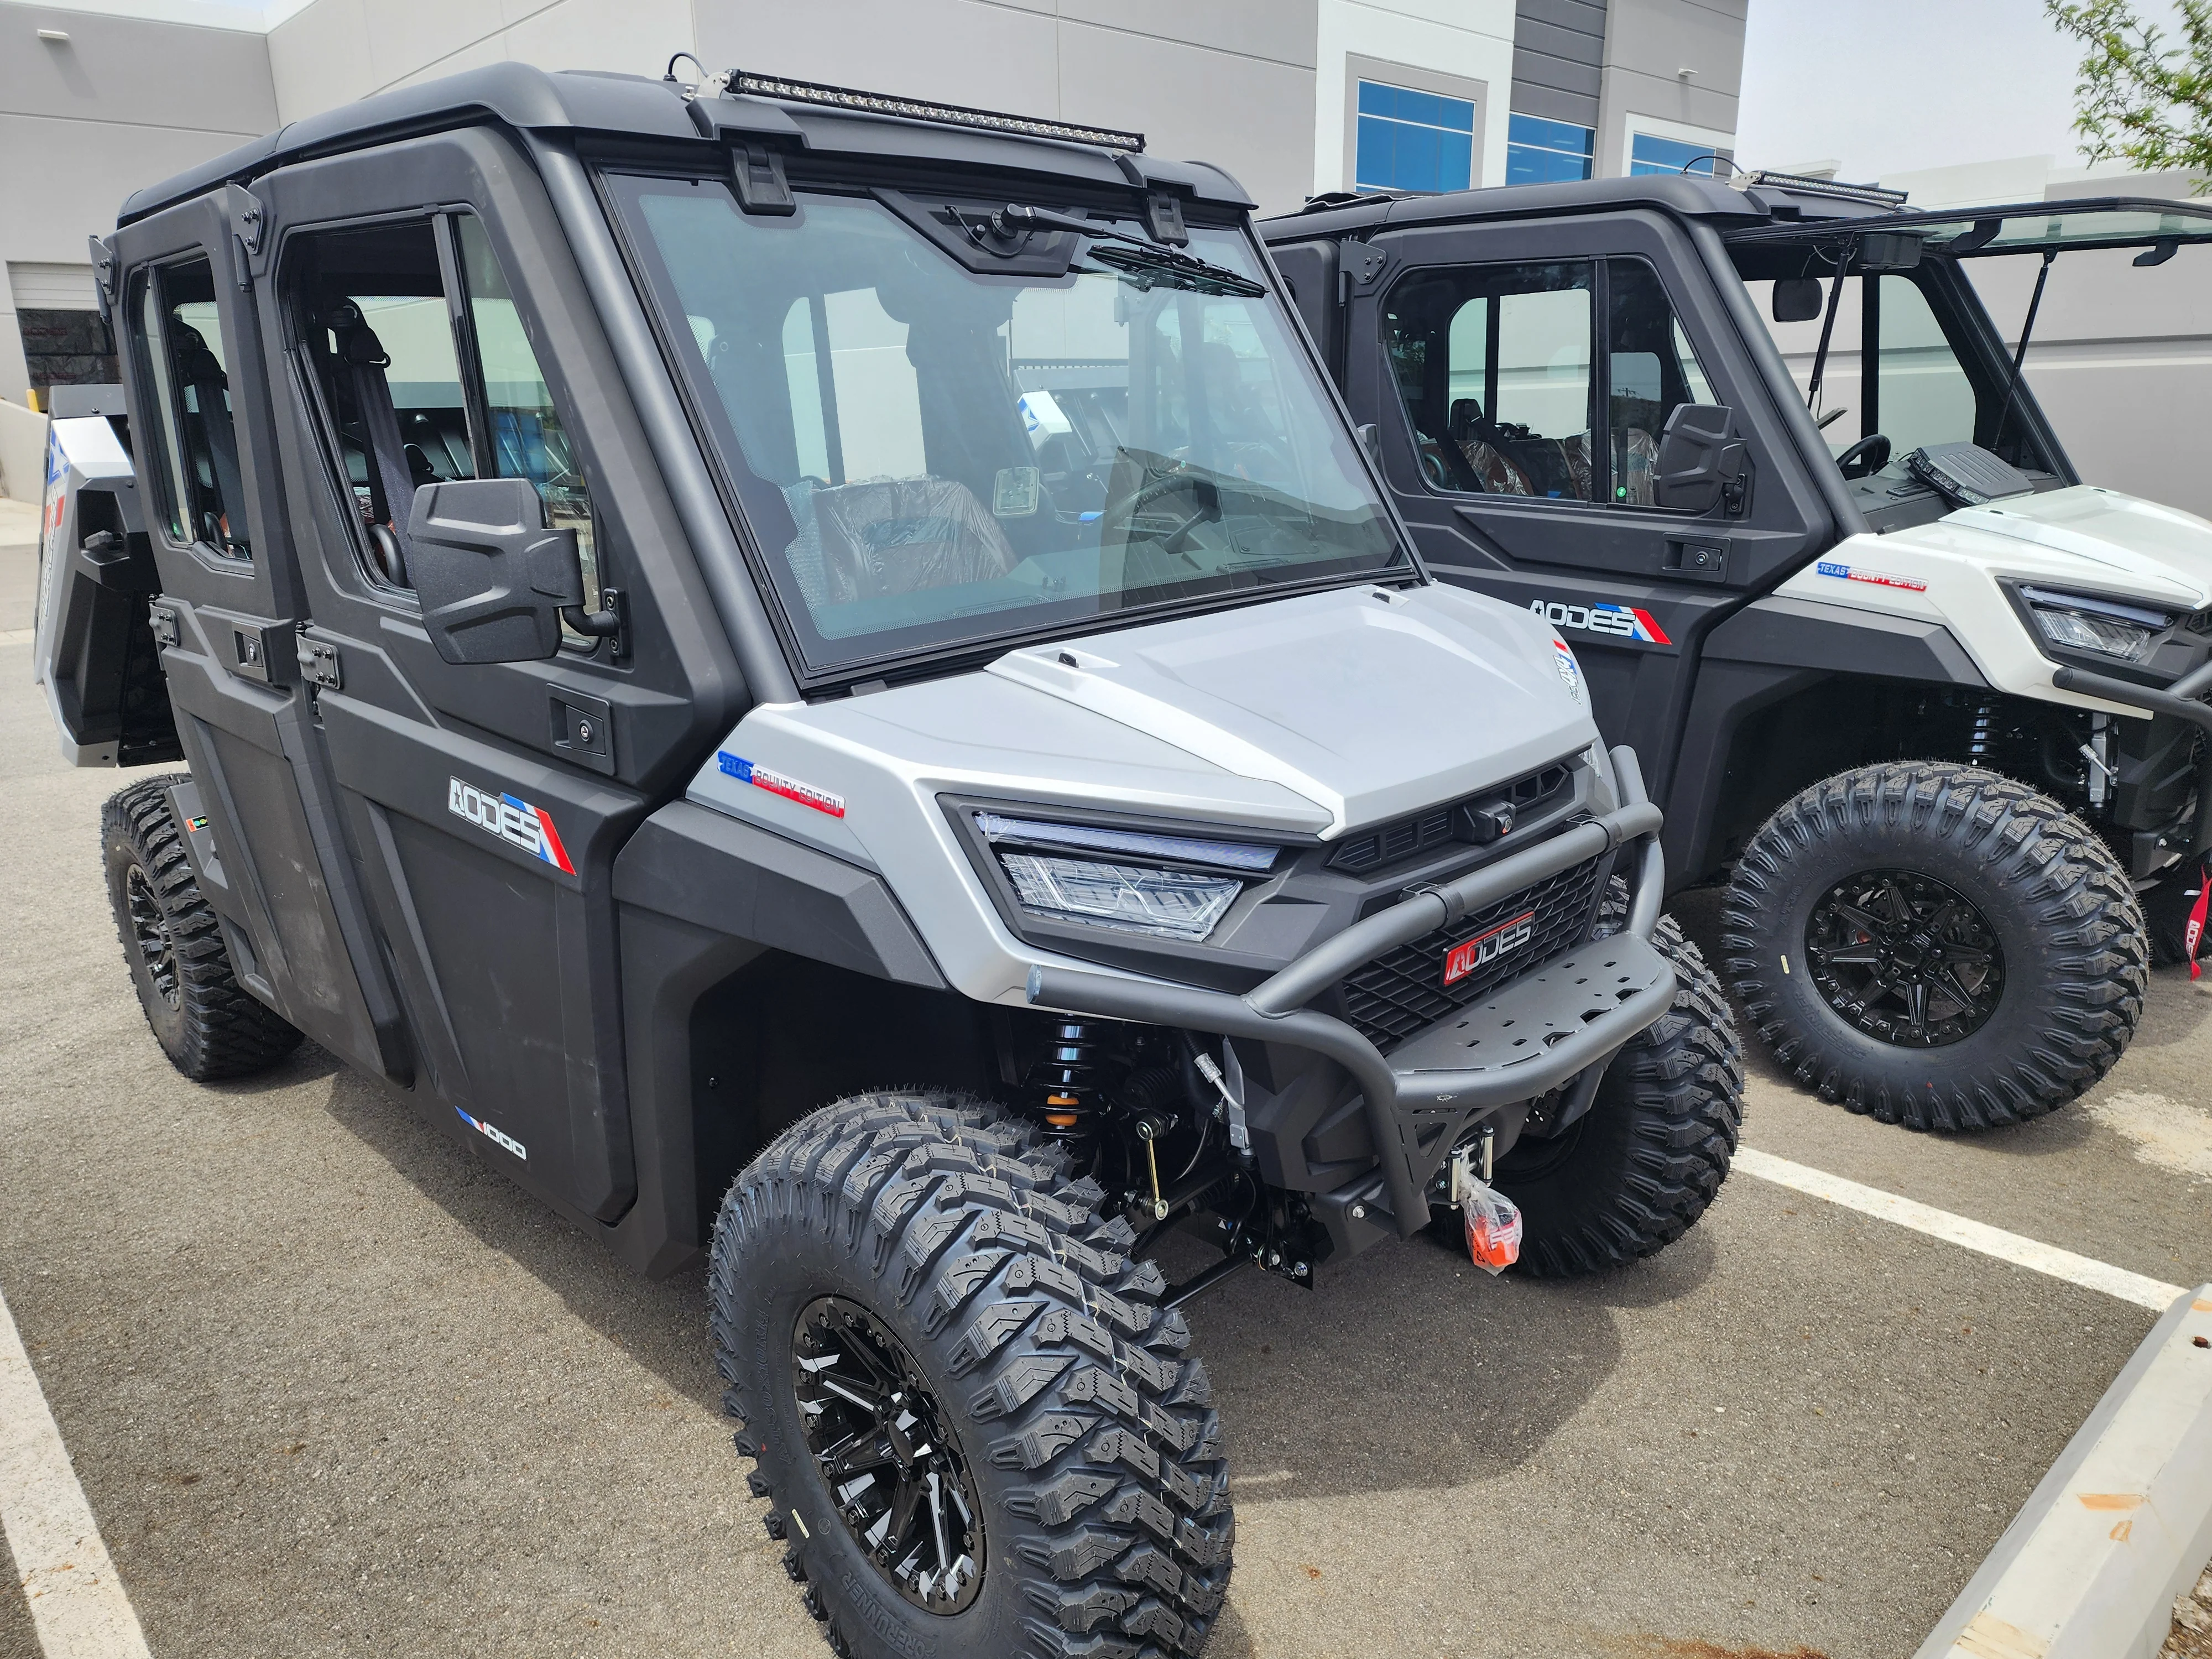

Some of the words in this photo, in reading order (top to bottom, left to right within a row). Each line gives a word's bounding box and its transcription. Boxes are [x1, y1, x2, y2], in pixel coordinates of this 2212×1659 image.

[1819, 563, 1846, 576] TEXAS
[1889, 576, 1926, 590] EDITION
[1530, 599, 1635, 637] AODES
[720, 755, 750, 779] TEXAS
[756, 770, 796, 794] BOUNTY
[800, 786, 840, 813] EDITION
[448, 779, 540, 854] AODES
[1448, 915, 1532, 980] AODES
[483, 1121, 527, 1160] 1000
